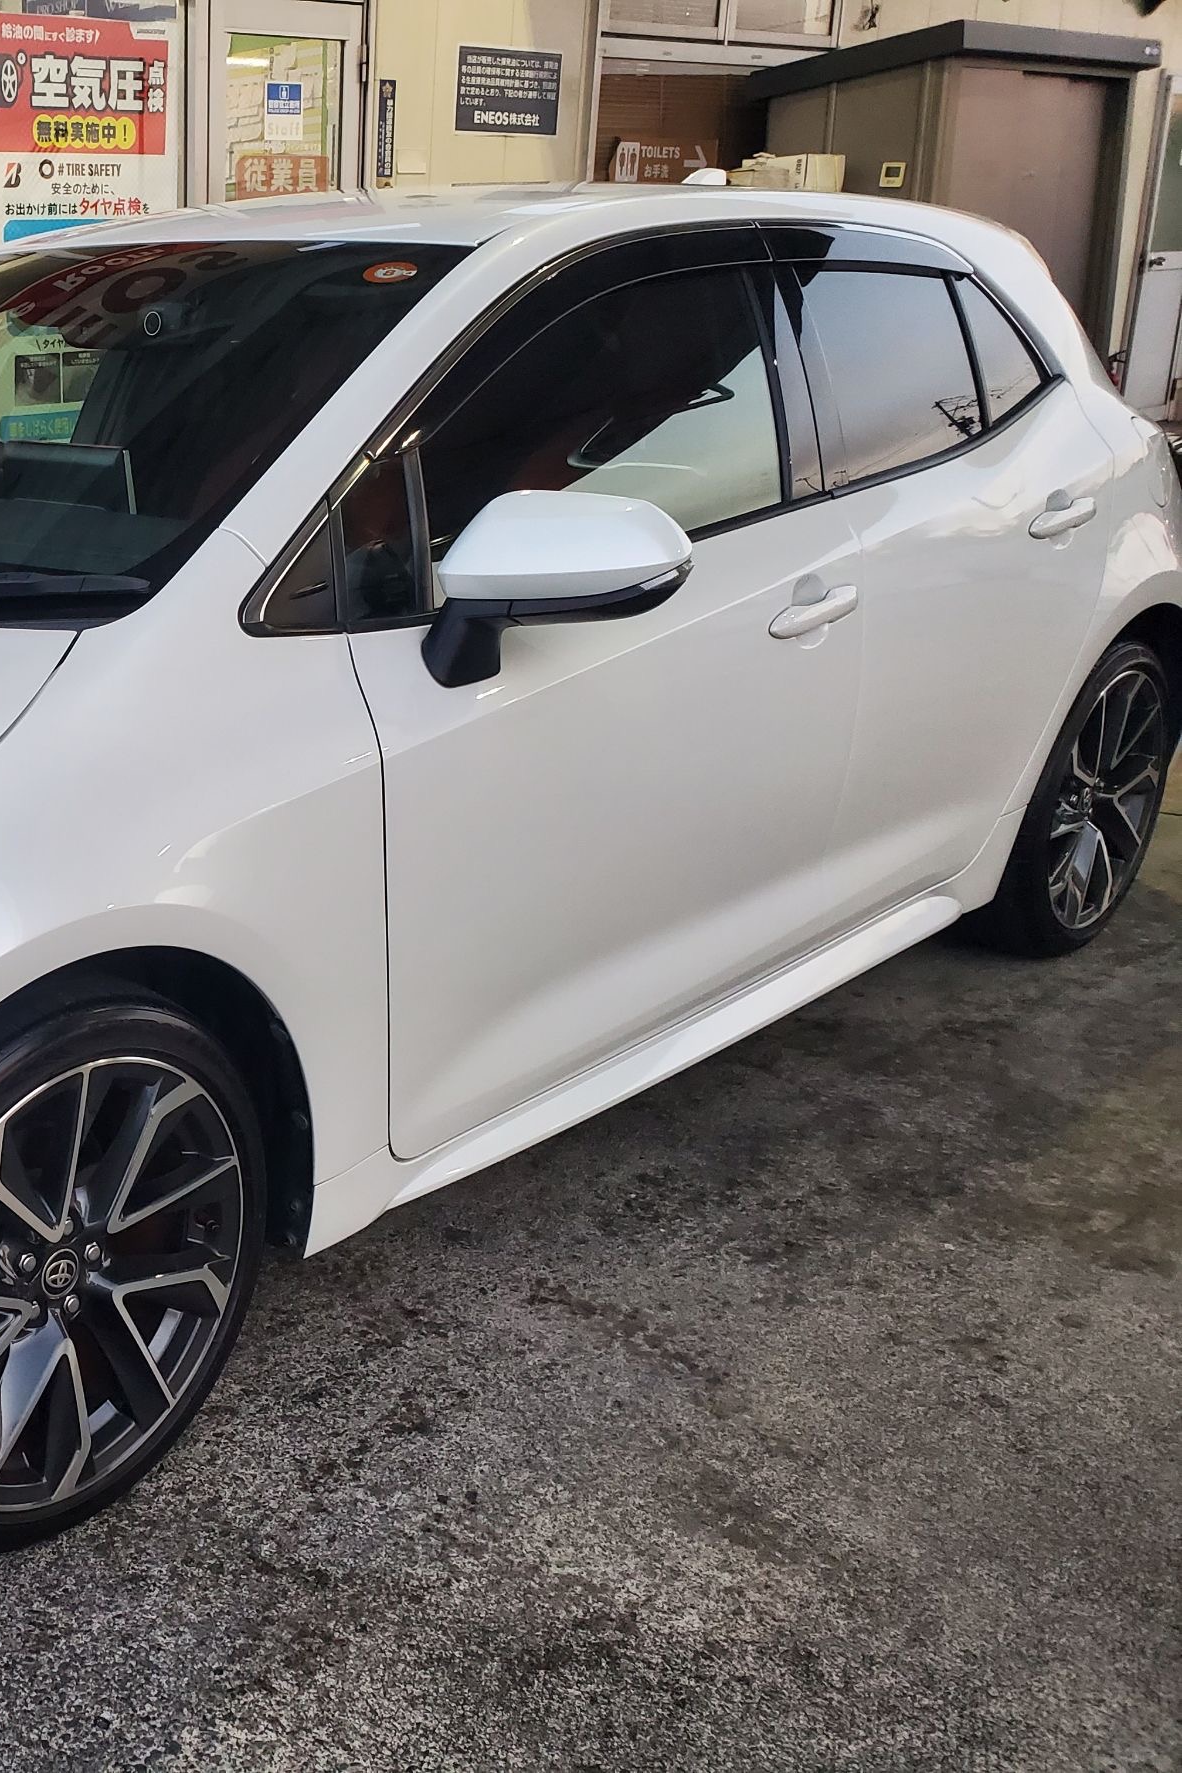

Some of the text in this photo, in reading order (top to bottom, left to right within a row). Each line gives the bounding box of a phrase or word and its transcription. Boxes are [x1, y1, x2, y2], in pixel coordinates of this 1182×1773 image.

[30, 54, 145, 113] 空気圧
[147, 60, 165, 113] 点検
[473, 110, 540, 126] ENEOS株式会社
[641, 145, 681, 159] TOILETS
[88, 163, 122, 177] SAFETY
[243, 157, 319, 193] 従業員
[51, 183, 116, 196] 安全のために、
